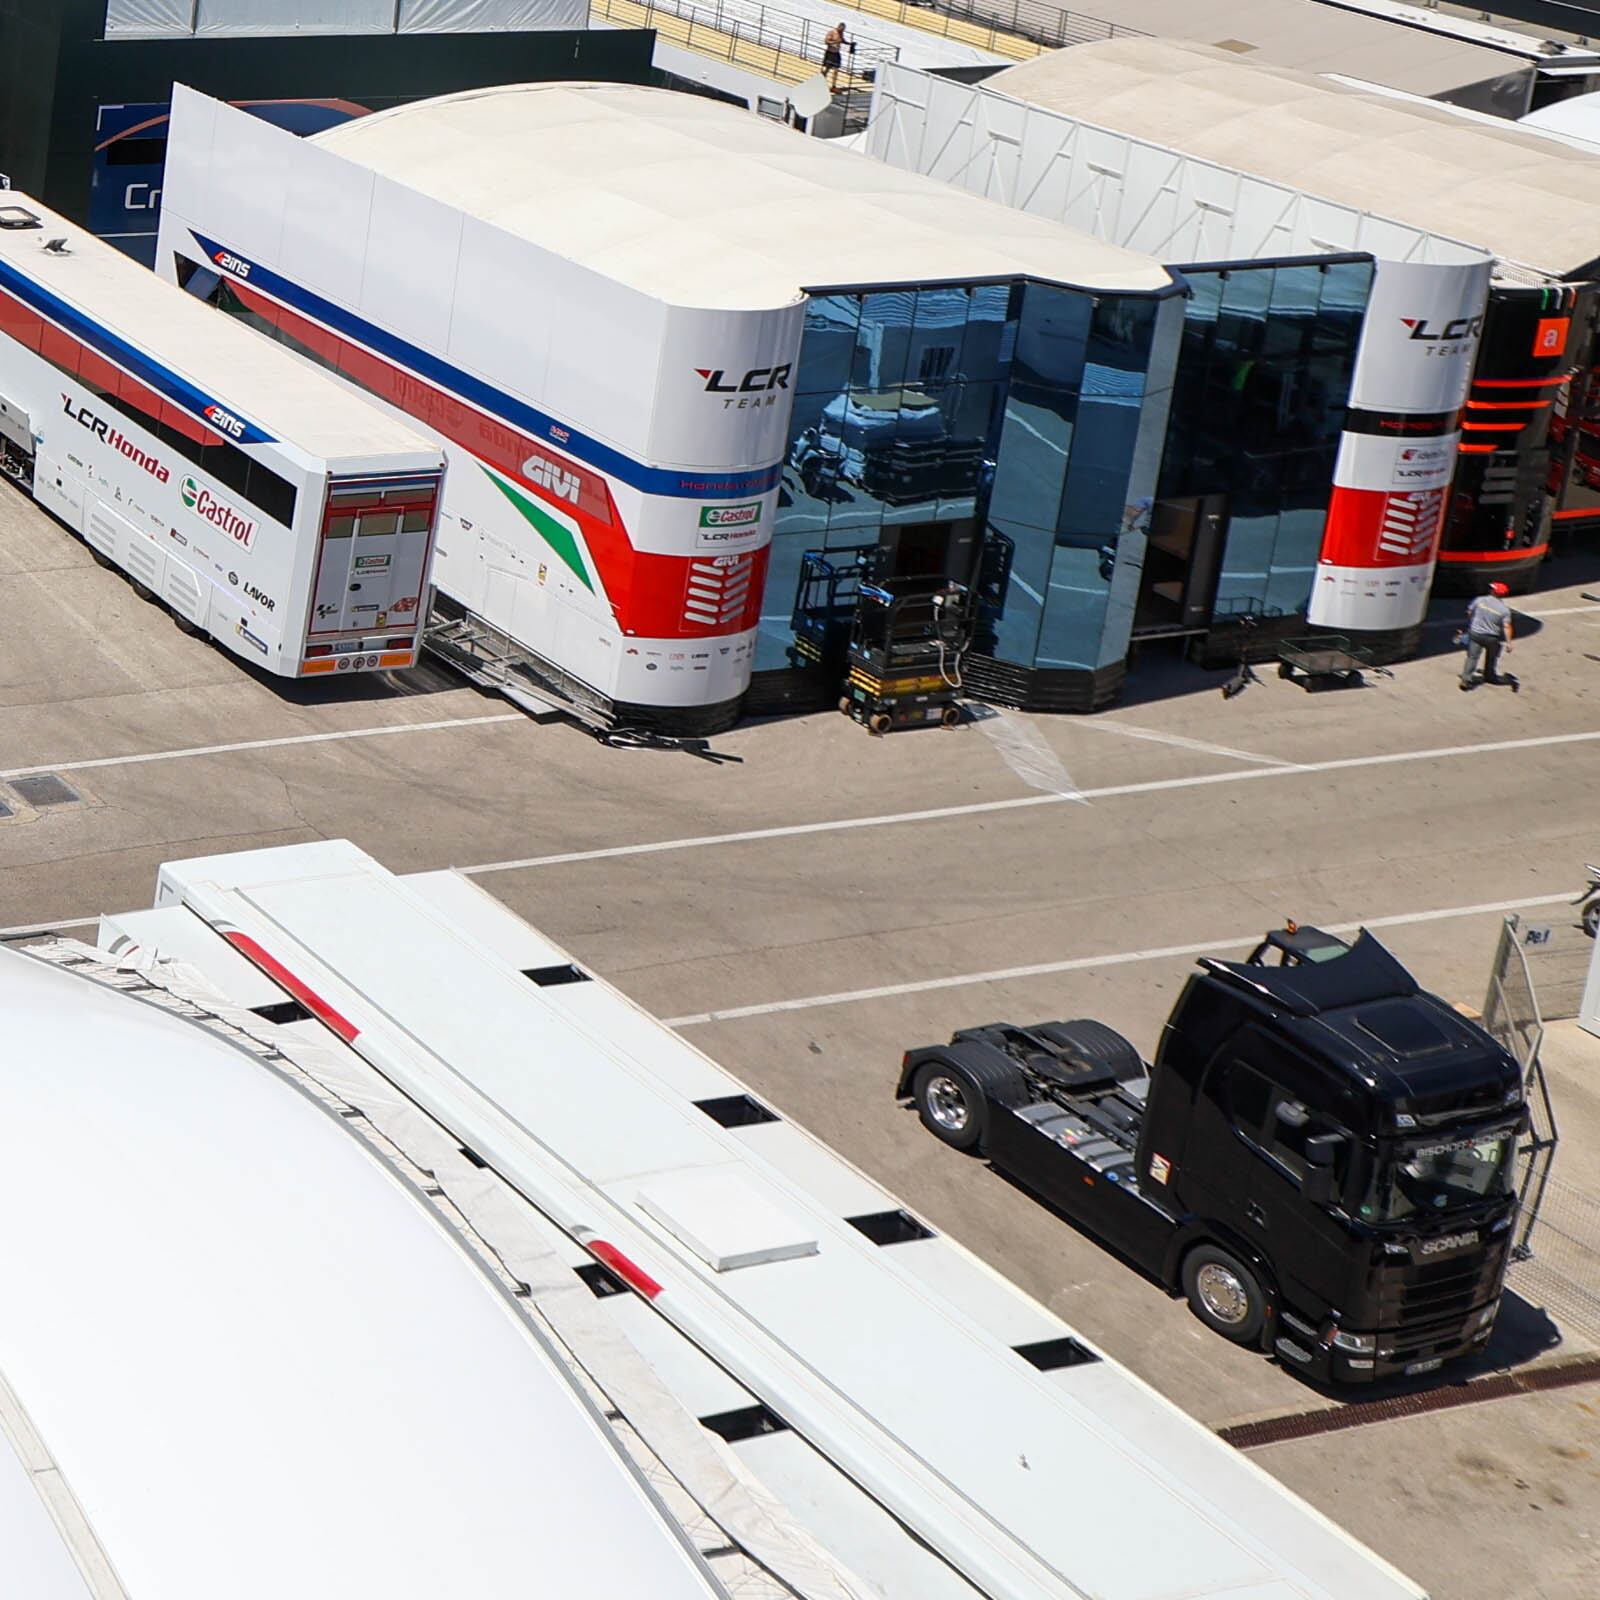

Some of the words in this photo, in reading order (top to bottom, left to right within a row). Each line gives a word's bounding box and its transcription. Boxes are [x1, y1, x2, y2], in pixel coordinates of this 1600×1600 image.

[1407, 314, 1484, 340] LCR
[702, 362, 793, 392] LCR
[722, 395, 778, 410] TEAM
[62, 396, 109, 444] LCR
[107, 428, 170, 484] Honda
[522, 454, 581, 504] GIVI
[196, 489, 253, 547] Castrol
[720, 507, 756, 523] Castrol
[705, 532, 730, 541] LCR
[713, 556, 740, 567] GIVI
[243, 581, 276, 612] LAVOR
[1416, 1139, 1468, 1158] BISCHOFF
[1420, 1230, 1480, 1255] SCANIA
